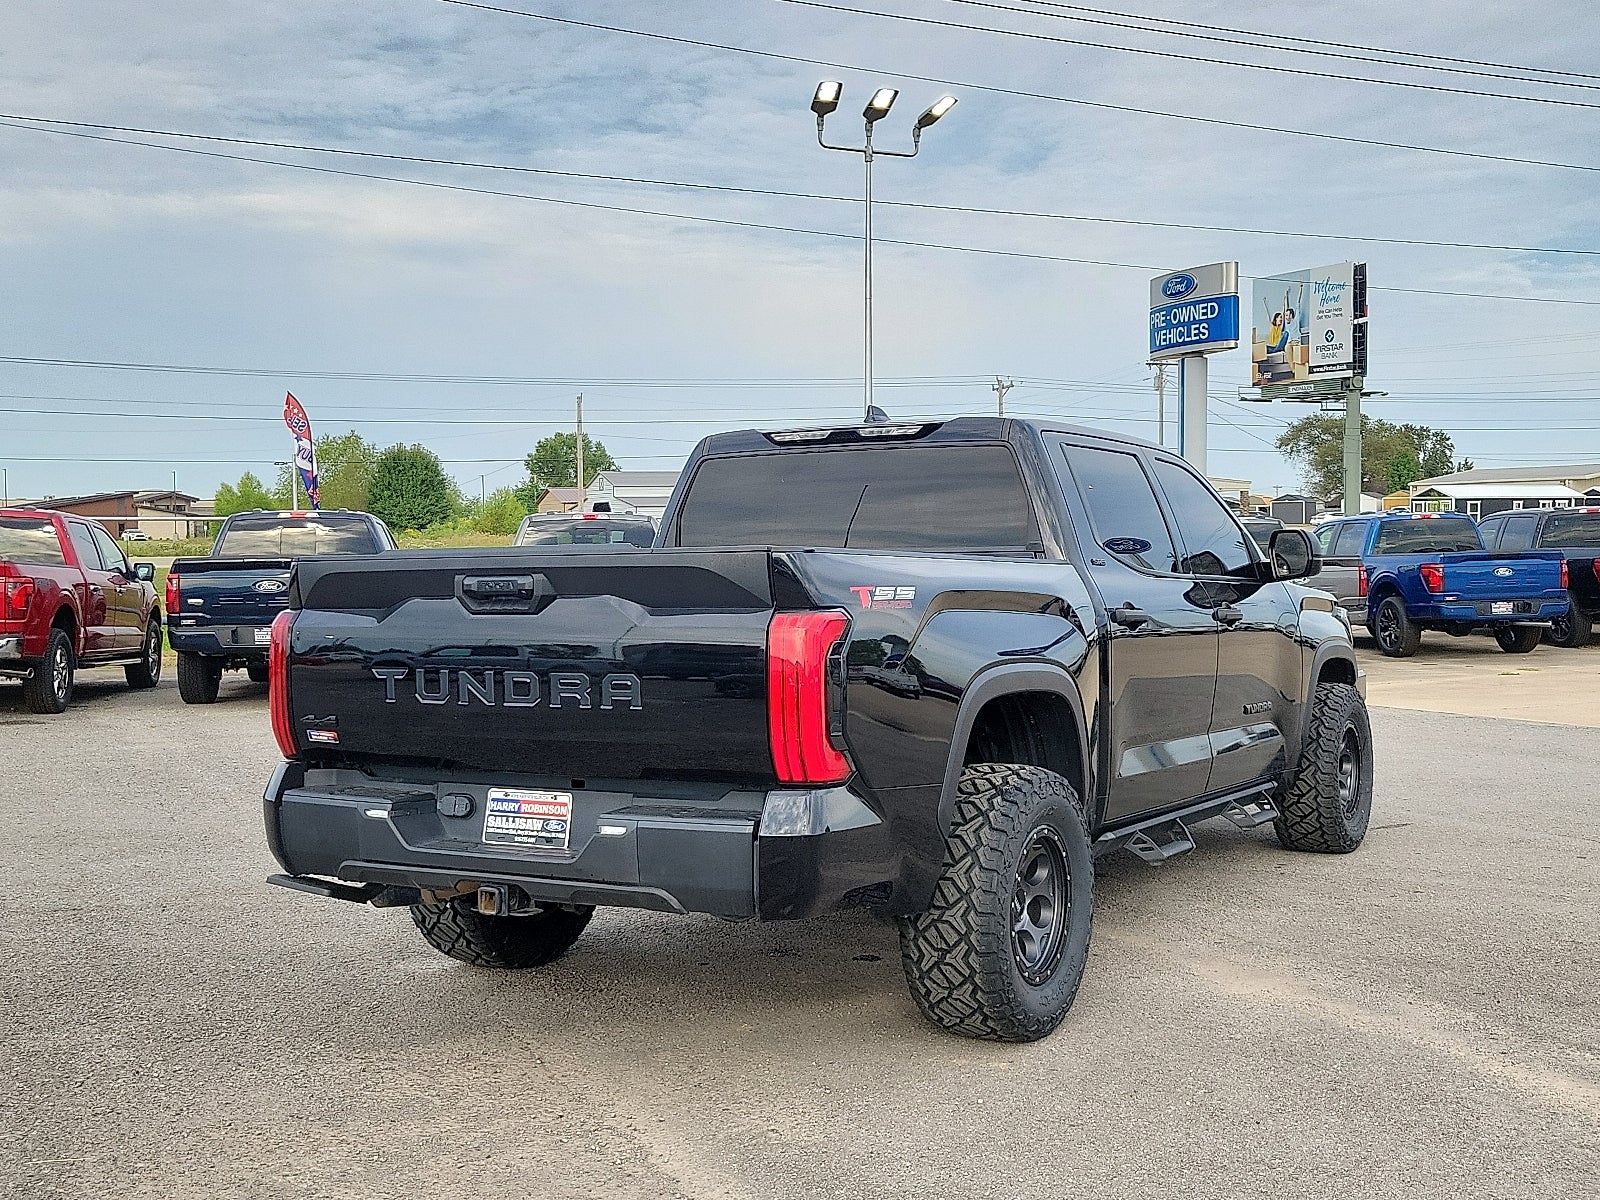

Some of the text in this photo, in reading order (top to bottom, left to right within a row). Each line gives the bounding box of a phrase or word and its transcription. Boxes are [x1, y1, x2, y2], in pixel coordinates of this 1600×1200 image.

[1166, 278, 1187, 295] Ford
[1313, 276, 1346, 295] Welcome
[1319, 292, 1340, 307] Home
[1150, 302, 1219, 330] PRE-OWNED
[1155, 322, 1209, 347] VEHICLES
[1315, 342, 1344, 354] FIRSTAR
[1321, 351, 1338, 360] BANK
[371, 668, 643, 710] TUNDRA
[1242, 700, 1273, 715] TUNDRA
[490, 800, 568, 816] HARRY ROBINSON
[487, 815, 543, 831] SALLISAW
